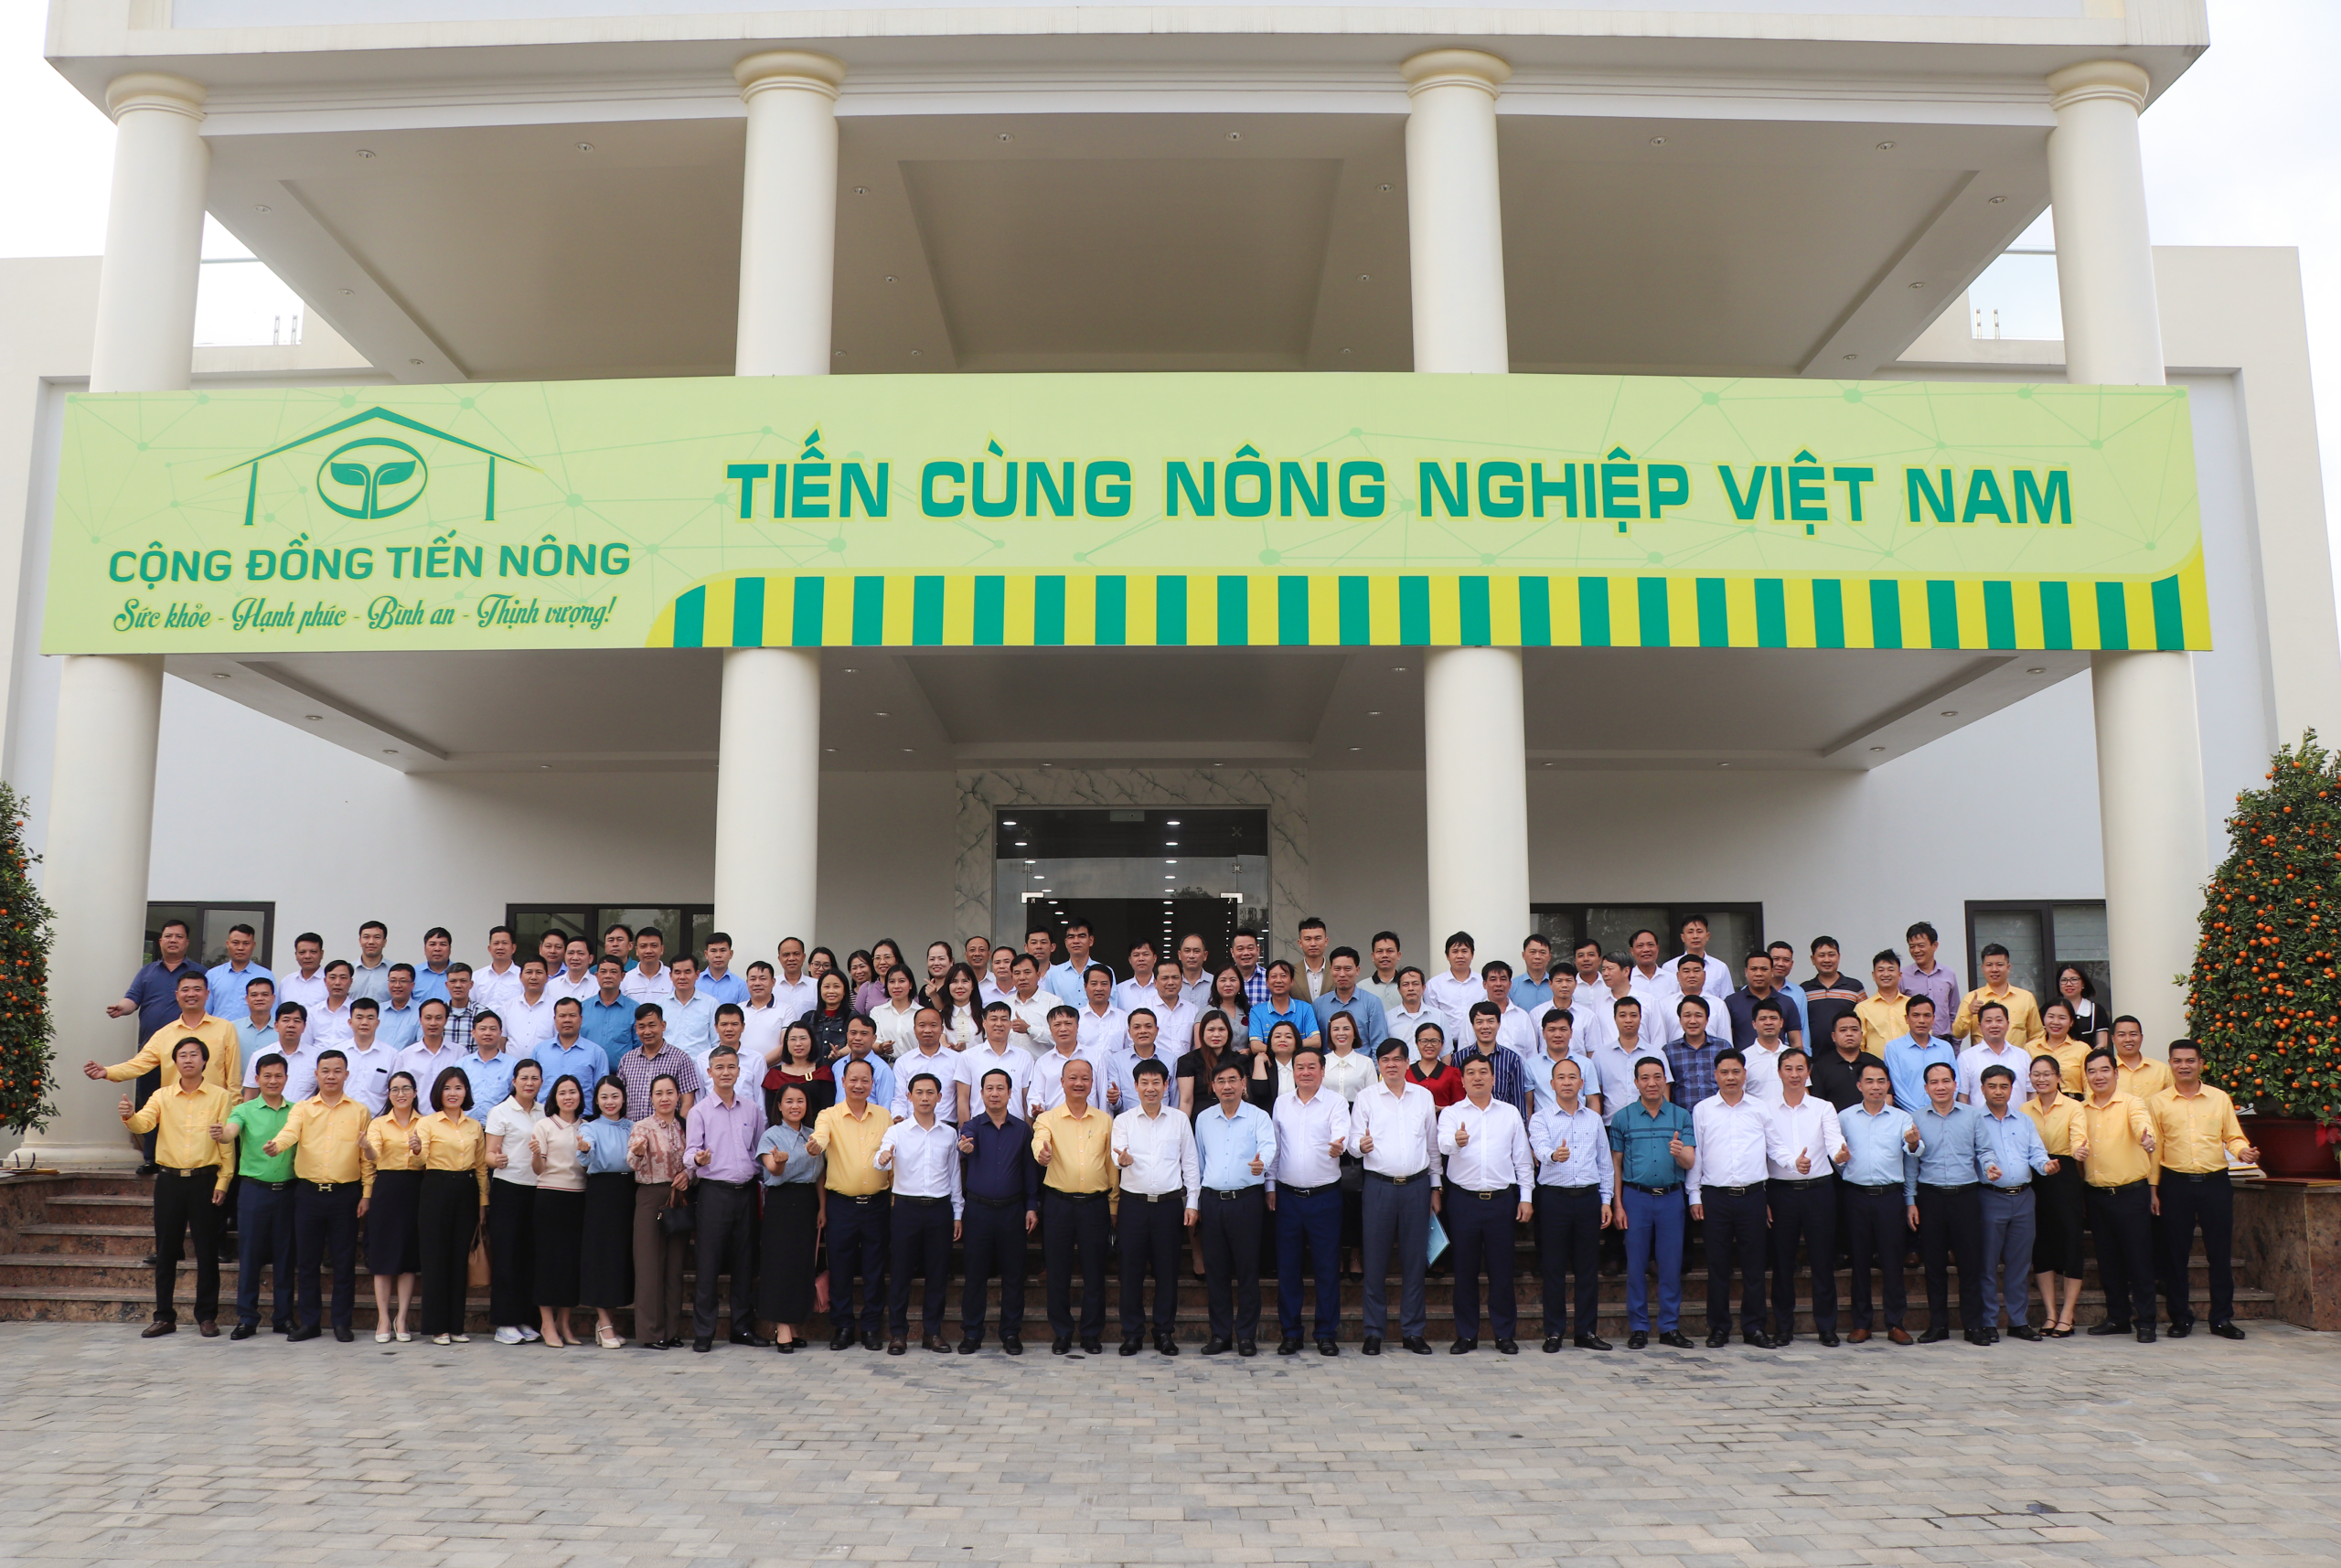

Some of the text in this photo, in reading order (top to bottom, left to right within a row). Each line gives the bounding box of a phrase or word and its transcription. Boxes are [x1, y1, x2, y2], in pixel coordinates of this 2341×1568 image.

[725, 428, 2073, 536] TIẾN CÙNG NÔNG NGHIỆP VIỆT NAM
[108, 529, 631, 590] CỘNG ĐỒNG TIẾN NÔNG
[112, 598, 162, 632] Sức
[163, 603, 211, 628] khỏe
[231, 597, 295, 633] Hạnh
[295, 601, 347, 635] phúc
[367, 594, 425, 630] Bình
[429, 607, 455, 625] an
[476, 593, 540, 629] Thịnh
[543, 595, 618, 630] vượng!
